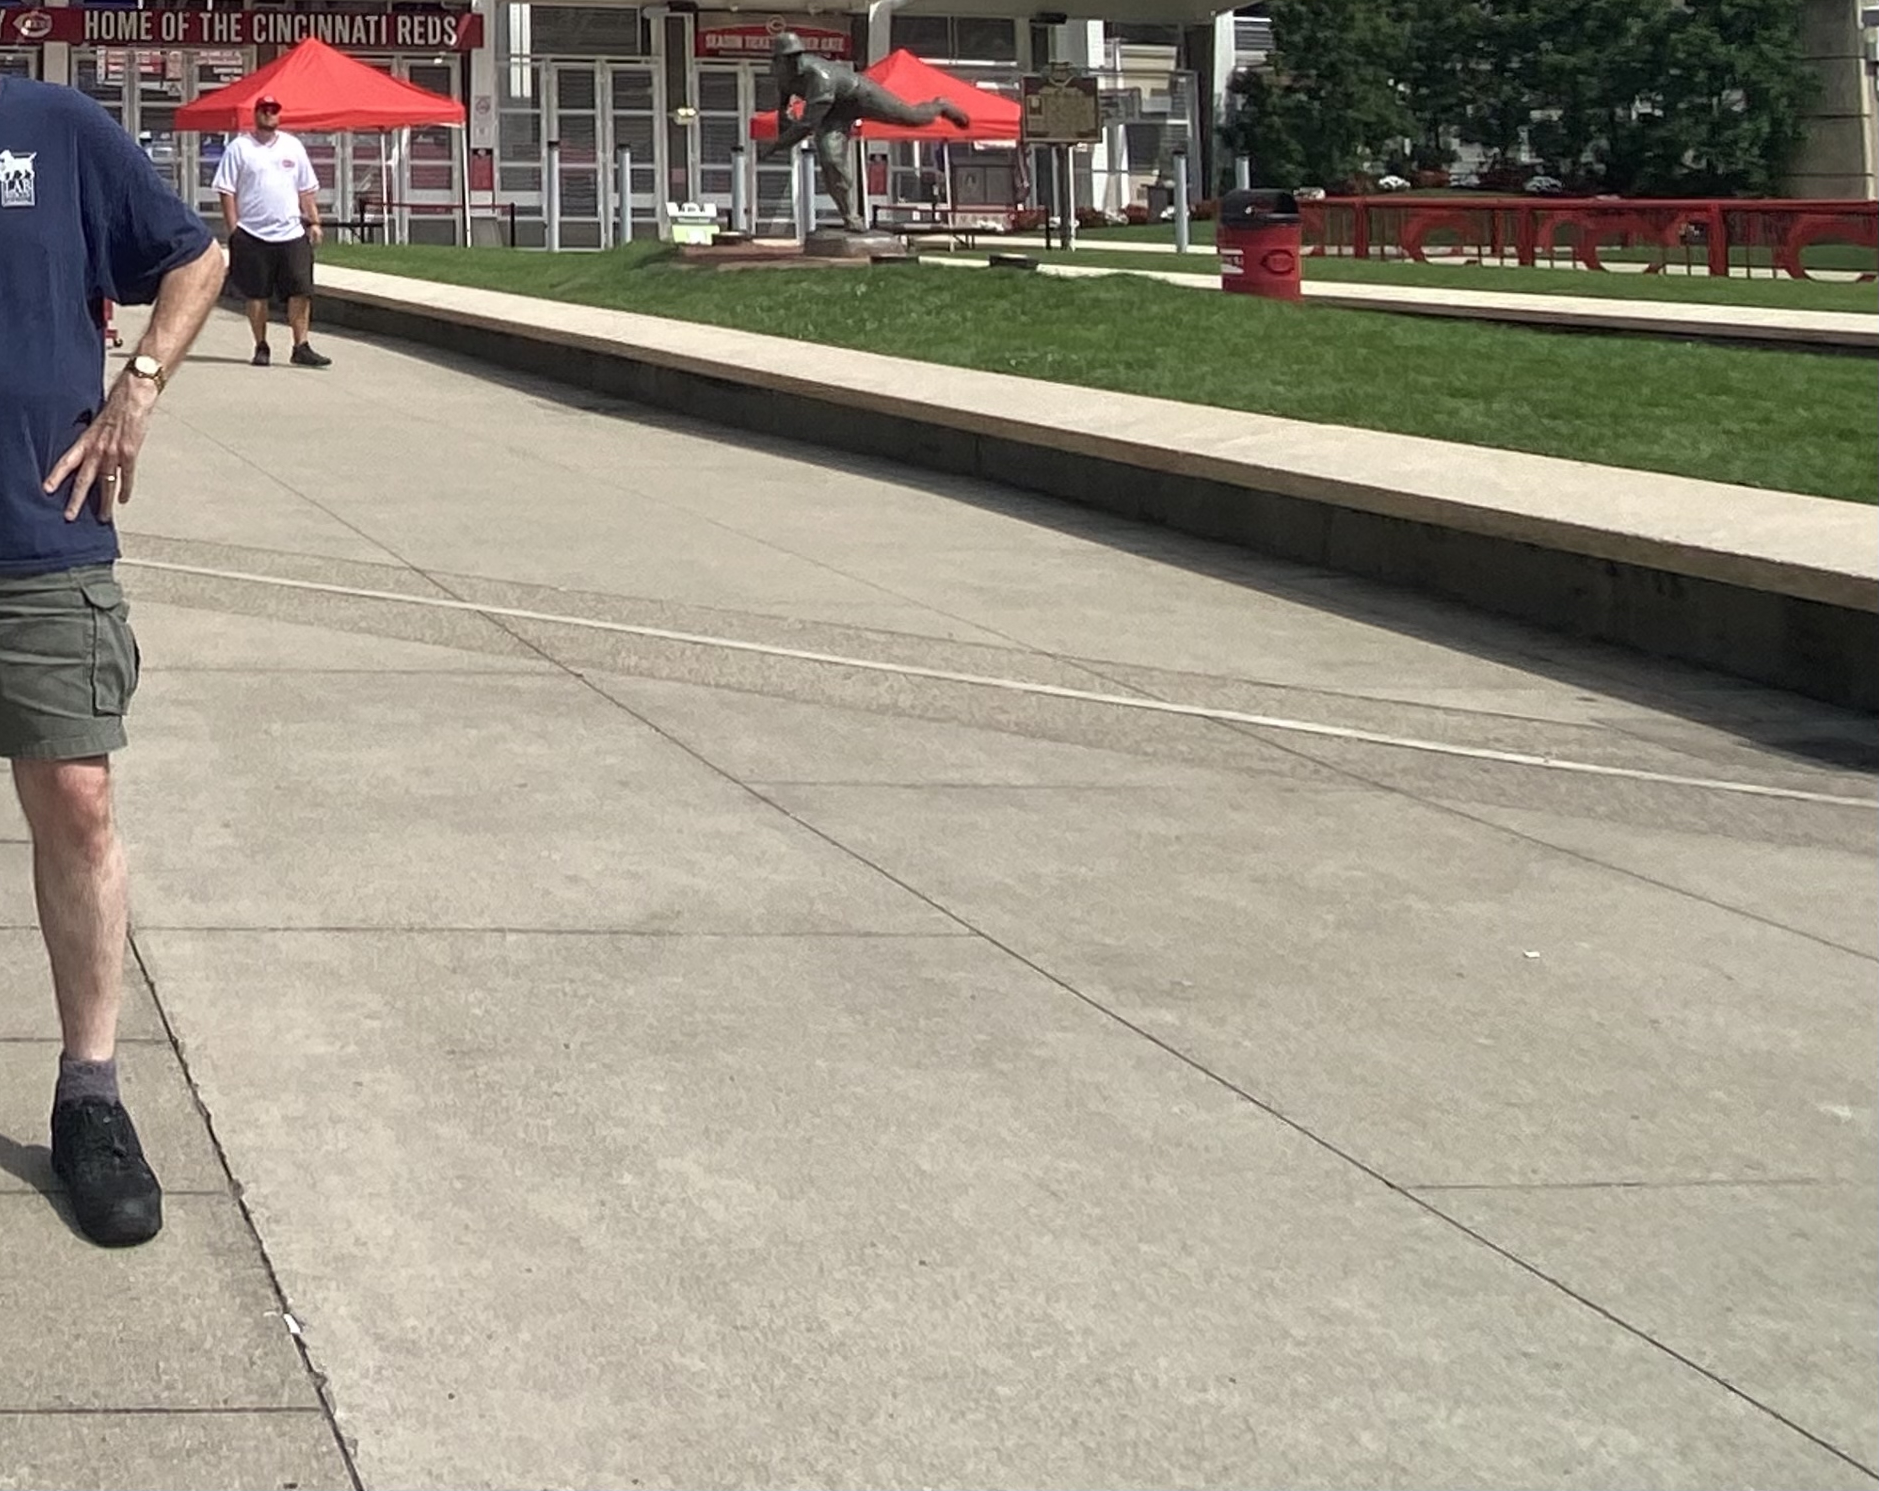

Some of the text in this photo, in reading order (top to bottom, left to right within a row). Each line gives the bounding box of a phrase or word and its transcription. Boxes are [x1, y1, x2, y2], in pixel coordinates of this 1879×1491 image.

[84, 10, 457, 46] HOME OF THE CINCINNATI REDS
